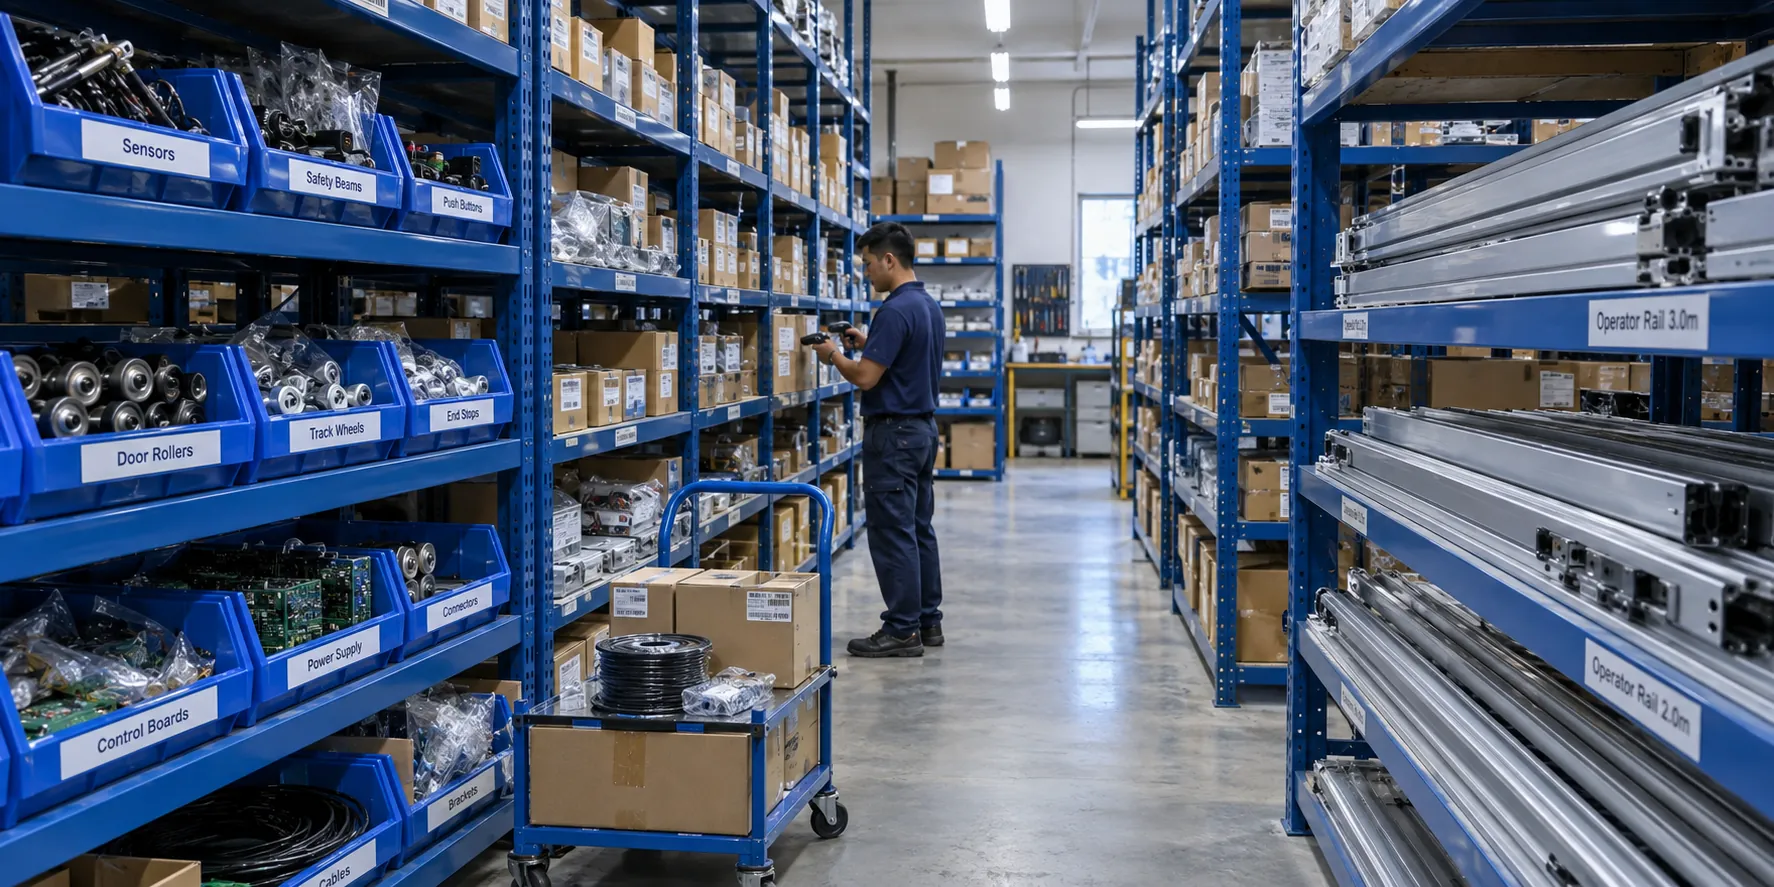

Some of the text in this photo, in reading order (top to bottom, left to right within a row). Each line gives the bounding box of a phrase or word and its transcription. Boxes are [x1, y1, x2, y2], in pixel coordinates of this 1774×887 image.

[122, 138, 175, 161] Sensors
[306, 170, 362, 192] Safety Beams
[443, 196, 483, 213] Push Buttons
[1597, 309, 1698, 334] Operator Rail 3.0m
[447, 409, 480, 422] End Stops
[309, 422, 365, 440] Track Wheels
[117, 445, 194, 466] Door Rollers
[442, 597, 478, 617] Connectors
[307, 641, 362, 672] Power Supply
[1592, 656, 1690, 737] Operator Rail 2.0m
[97, 708, 189, 753] Control Boards
[448, 786, 478, 811] Brackets
[319, 866, 351, 887] Cables
